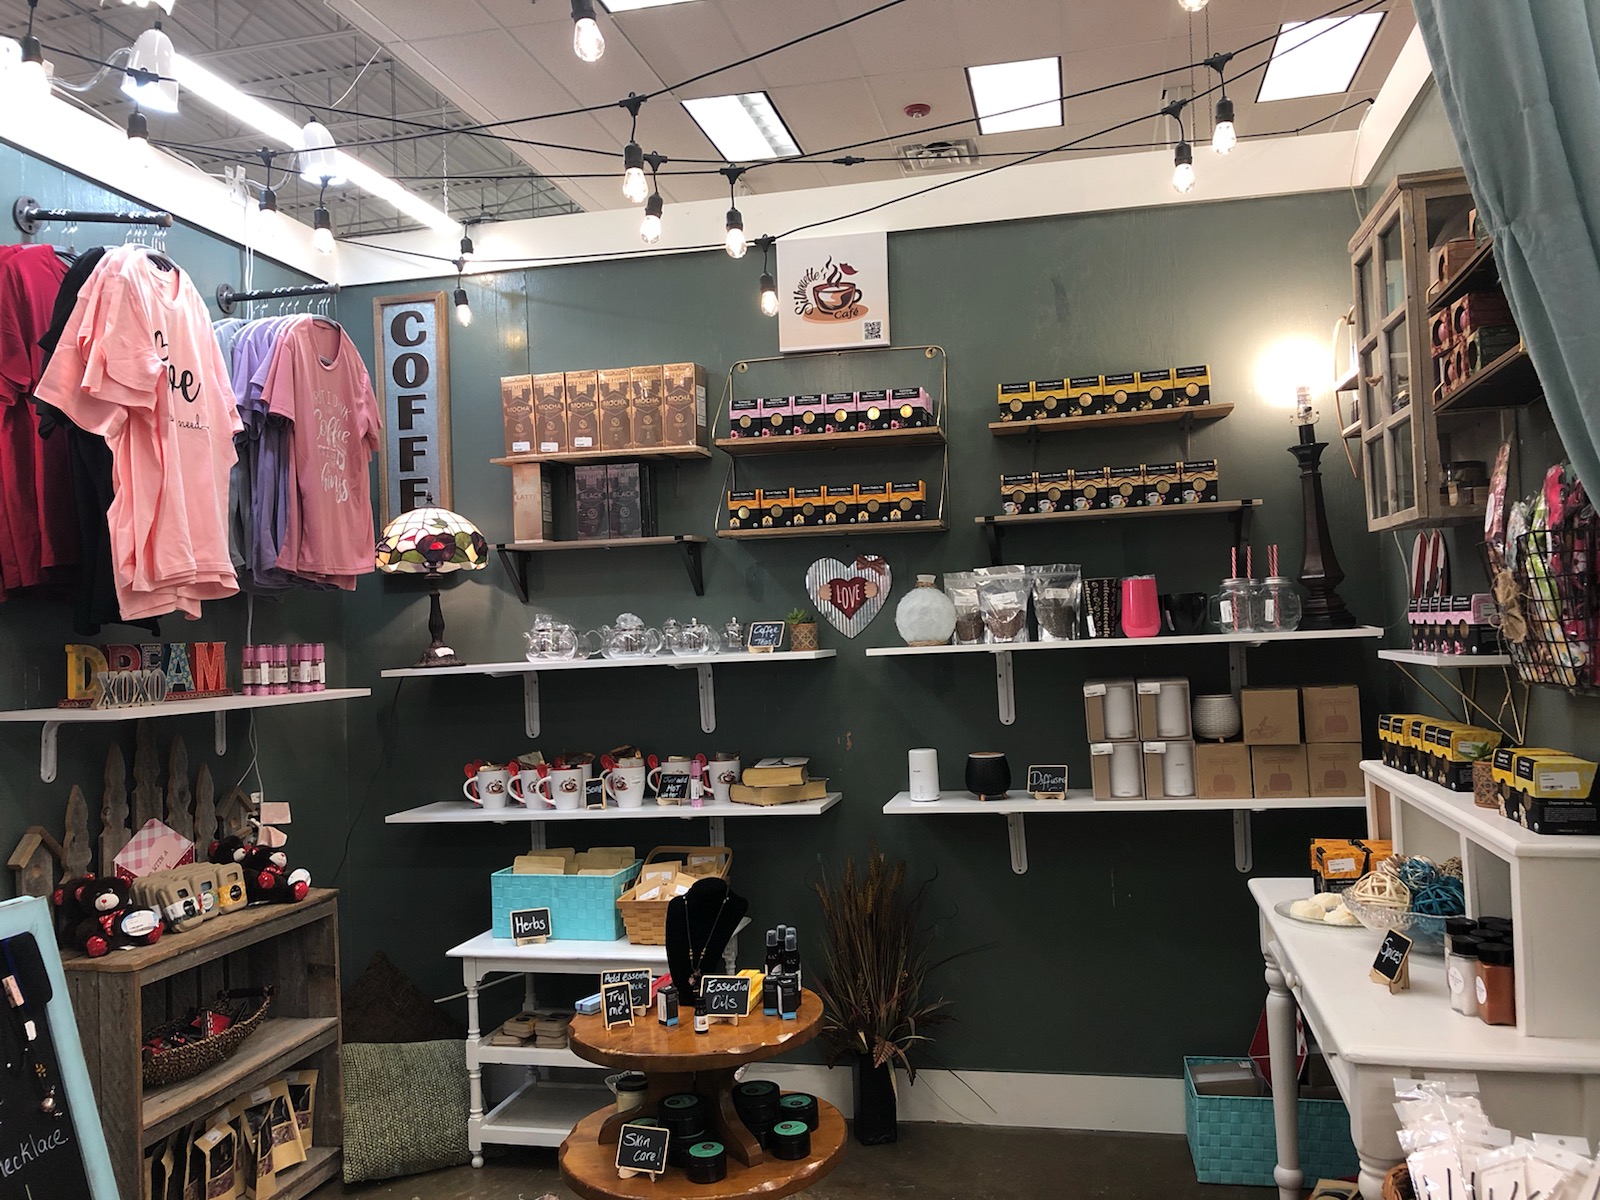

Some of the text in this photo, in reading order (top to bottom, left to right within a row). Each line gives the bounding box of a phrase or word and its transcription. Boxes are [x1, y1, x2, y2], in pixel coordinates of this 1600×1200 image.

[834, 307, 859, 319] Café
[836, 584, 860, 609] LOVE
[754, 625, 779, 638] Coffee
[65, 642, 227, 700] DREAM
[97, 669, 166, 706] XOXO
[515, 916, 546, 934] Herbs
[1380, 937, 1403, 964] Spices
[604, 973, 621, 983] Add
[712, 994, 738, 1010] Oils
[623, 1133, 651, 1148] Skin
